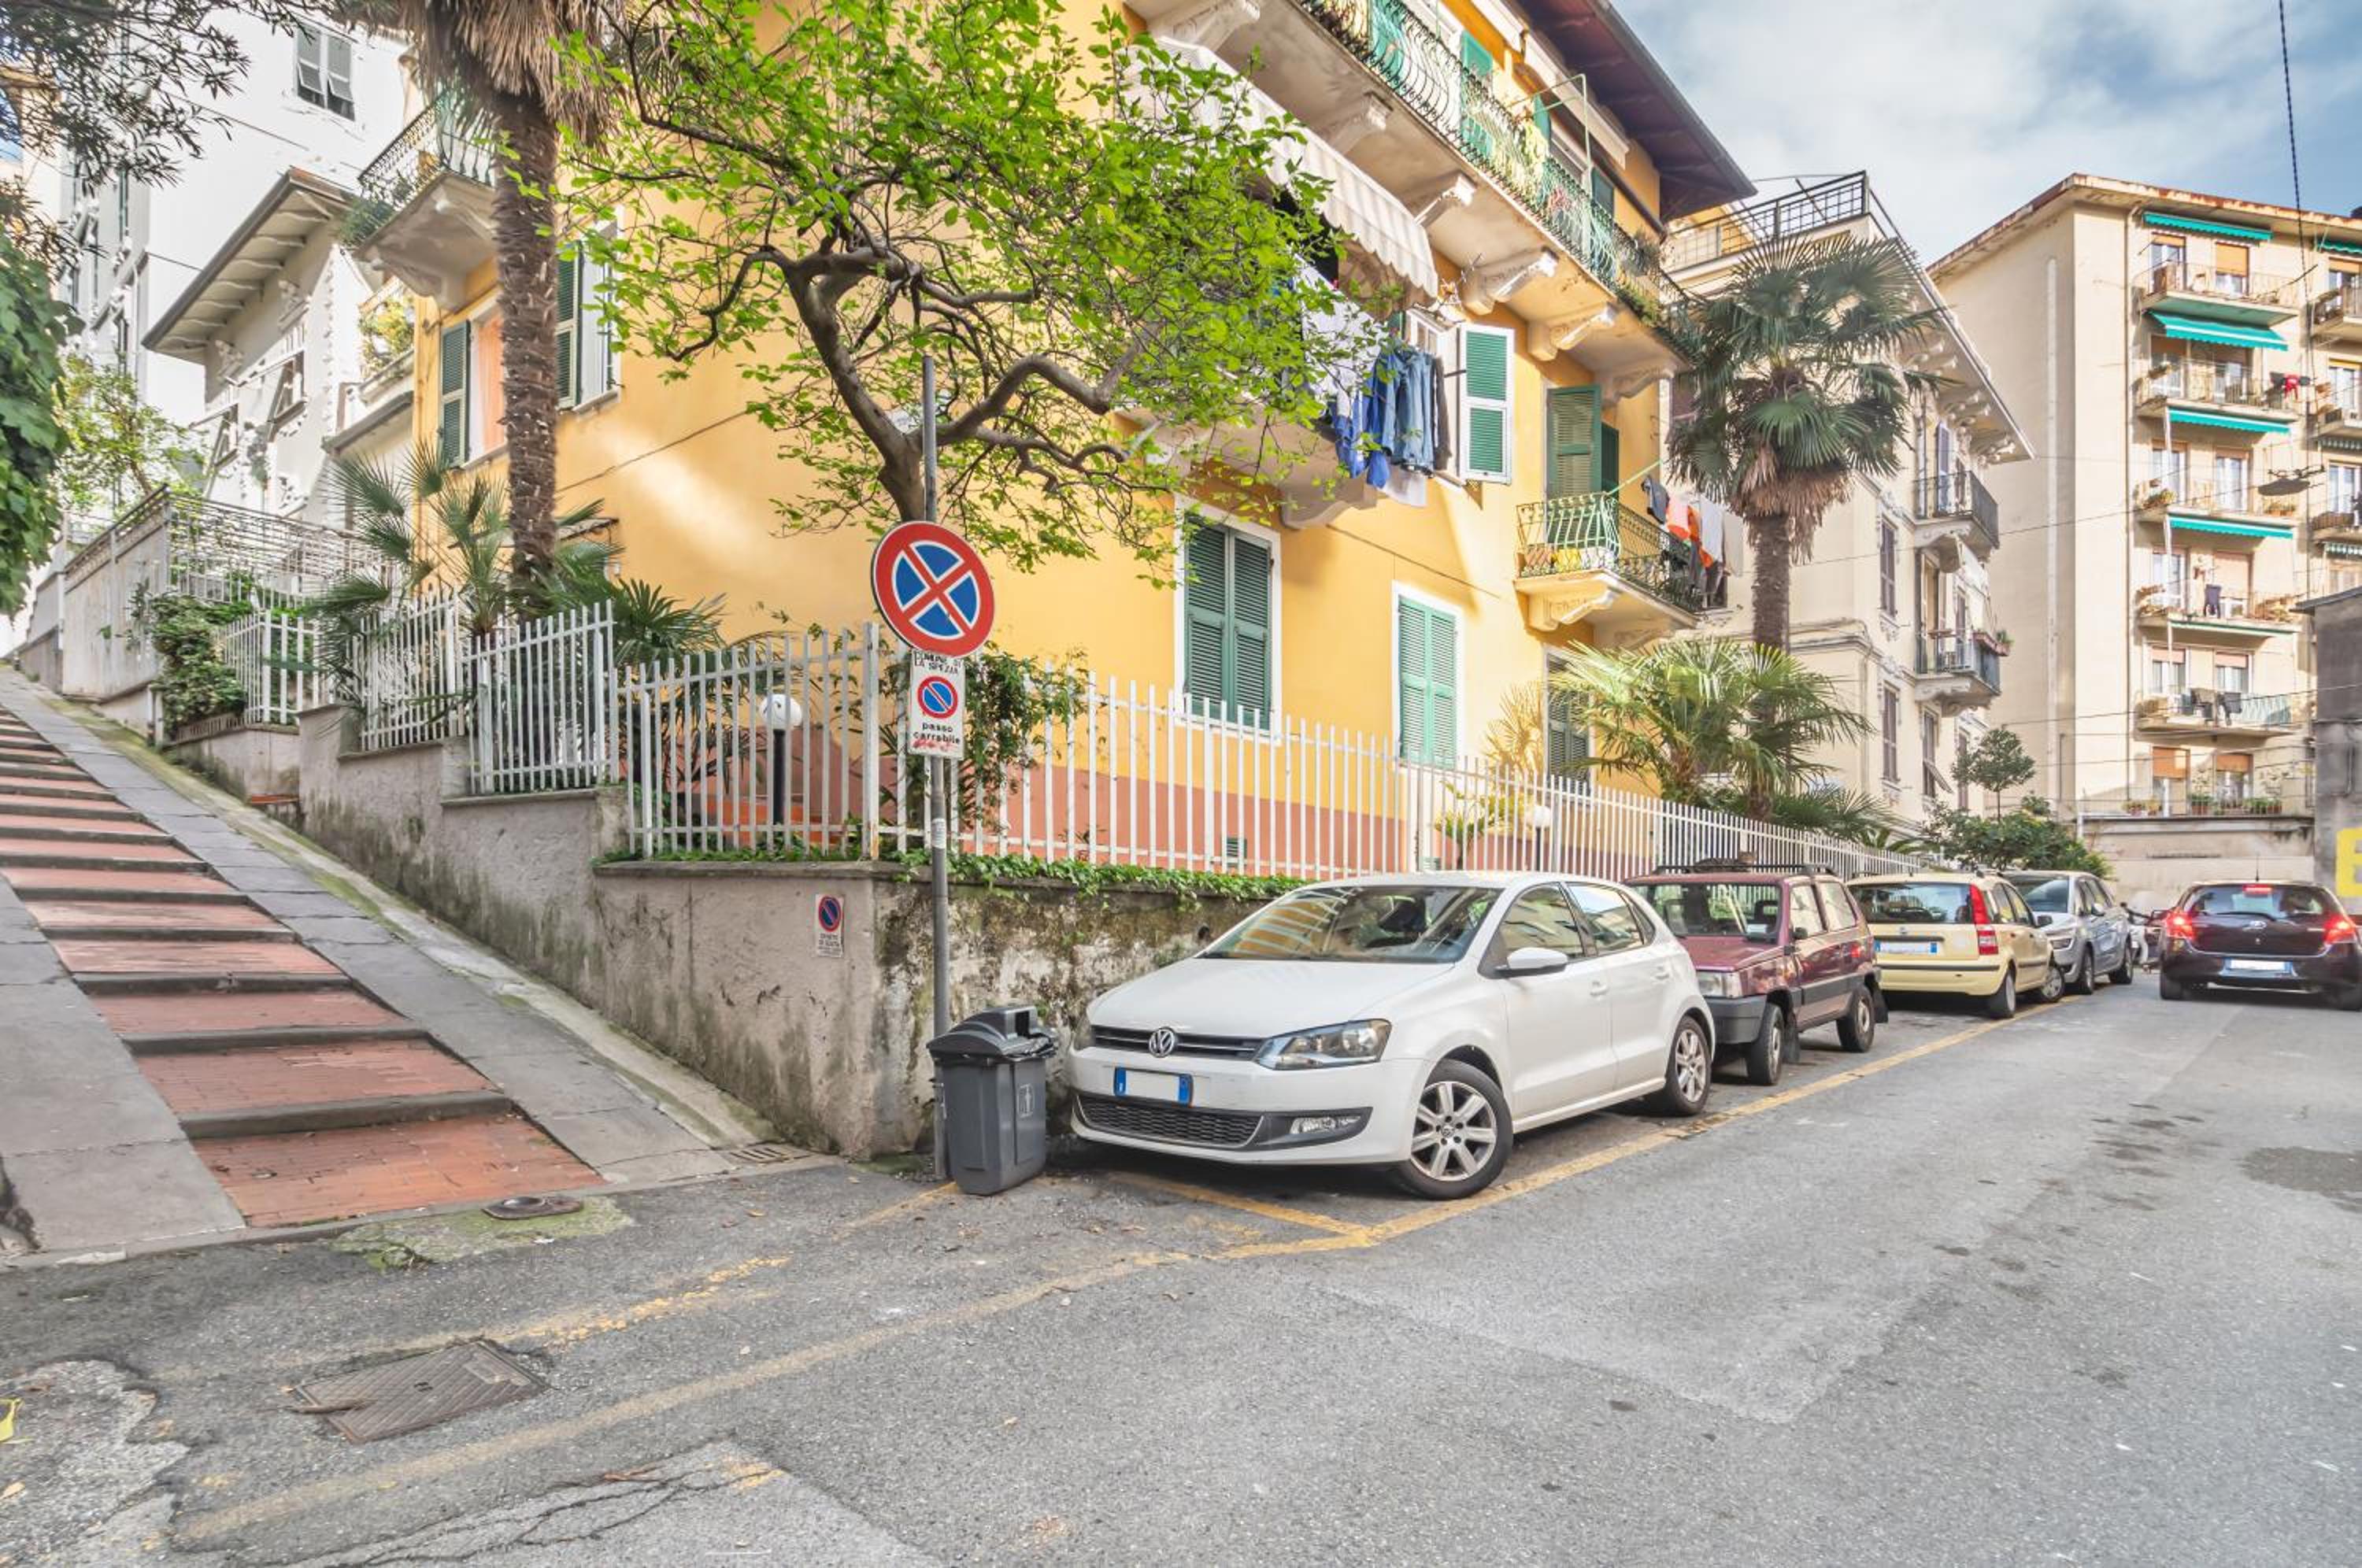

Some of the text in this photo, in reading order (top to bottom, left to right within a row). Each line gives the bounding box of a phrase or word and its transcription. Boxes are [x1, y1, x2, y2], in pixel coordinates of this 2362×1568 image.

[928, 662, 958, 675] SPEZIA
[922, 723, 953, 733] passo
[913, 731, 960, 745] carrabile
